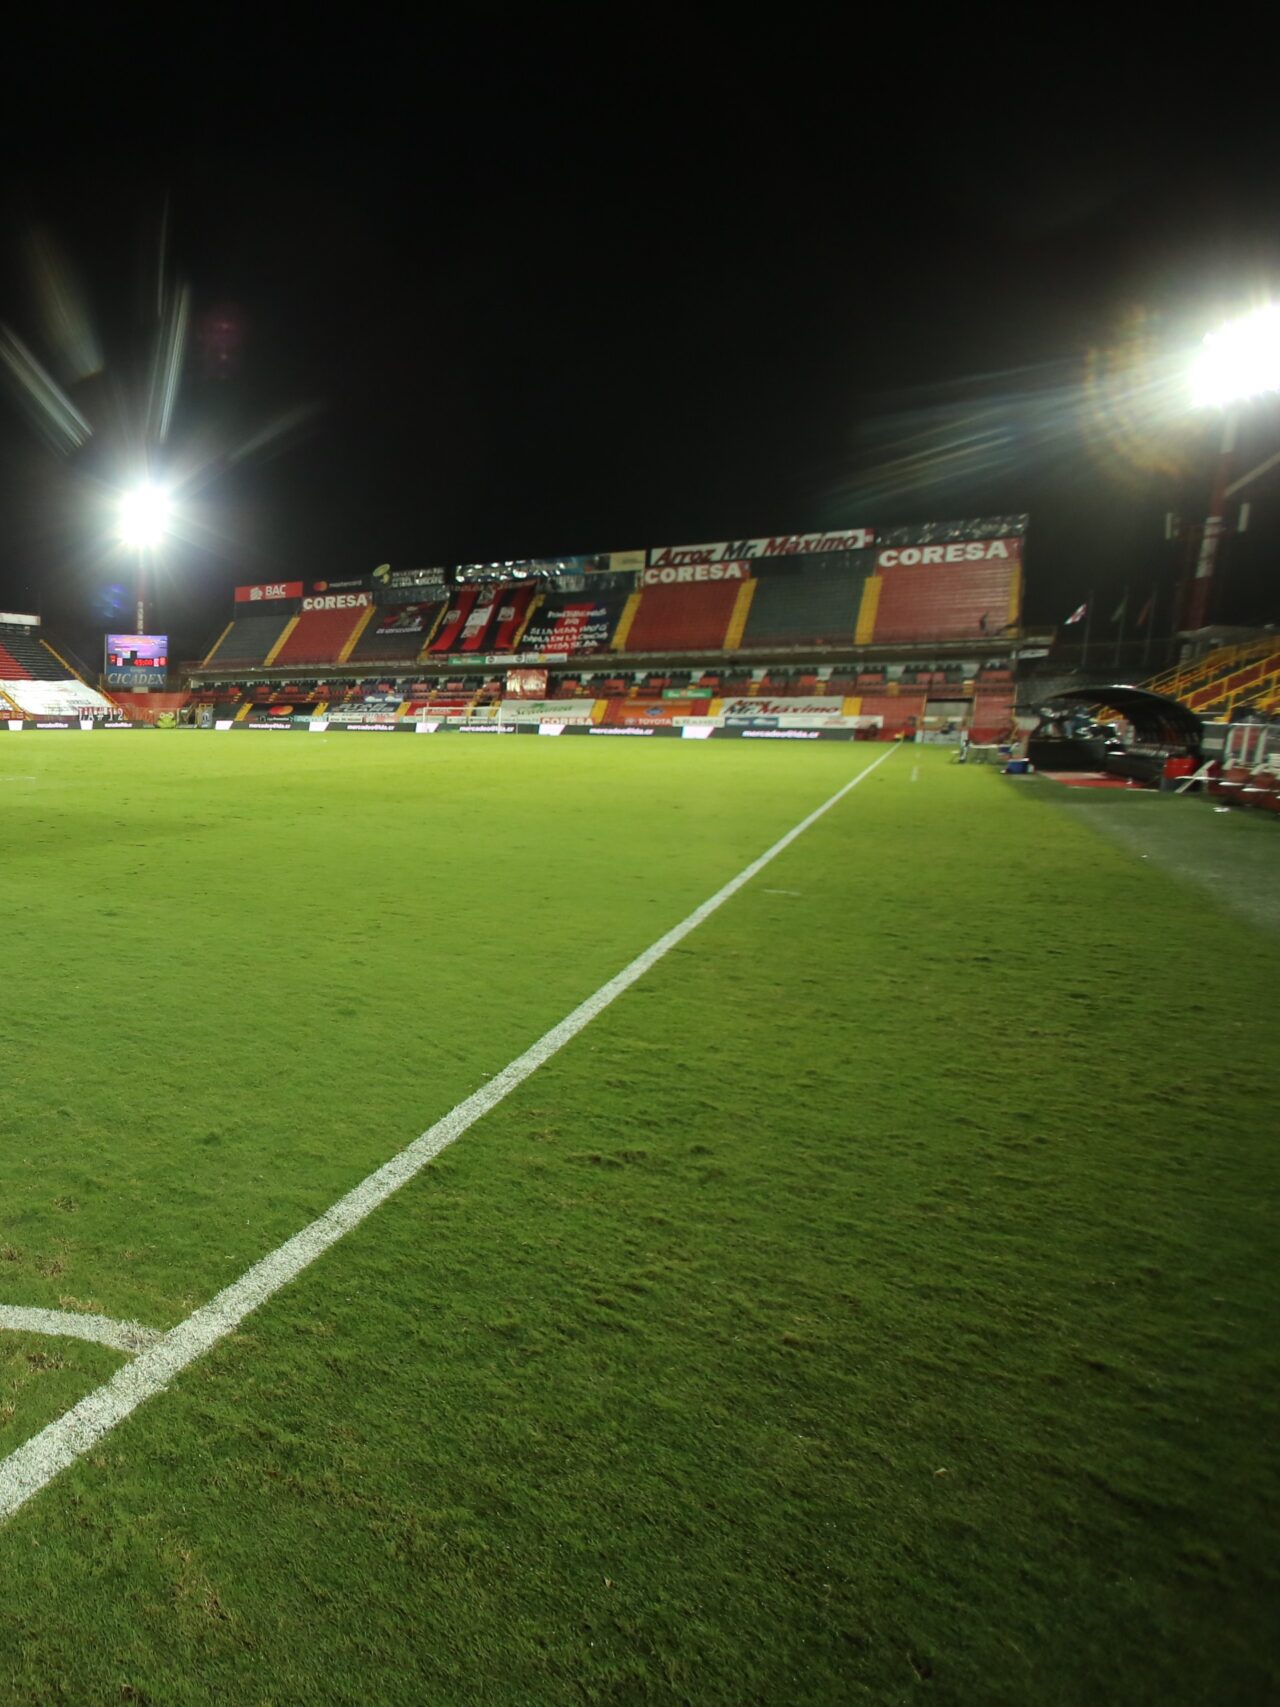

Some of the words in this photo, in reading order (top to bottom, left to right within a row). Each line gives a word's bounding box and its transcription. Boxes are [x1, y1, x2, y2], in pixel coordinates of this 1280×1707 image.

[655, 547, 717, 566] Arroz
[878, 540, 1009, 568] CORESA
[645, 562, 742, 585] CORESA
[265, 584, 287, 595] BAC
[303, 593, 368, 610] CORESA
[107, 672, 166, 685] CICADEX
[638, 717, 673, 726] TOYOTA
[741, 729, 820, 739] mercadeo@lda.cr
